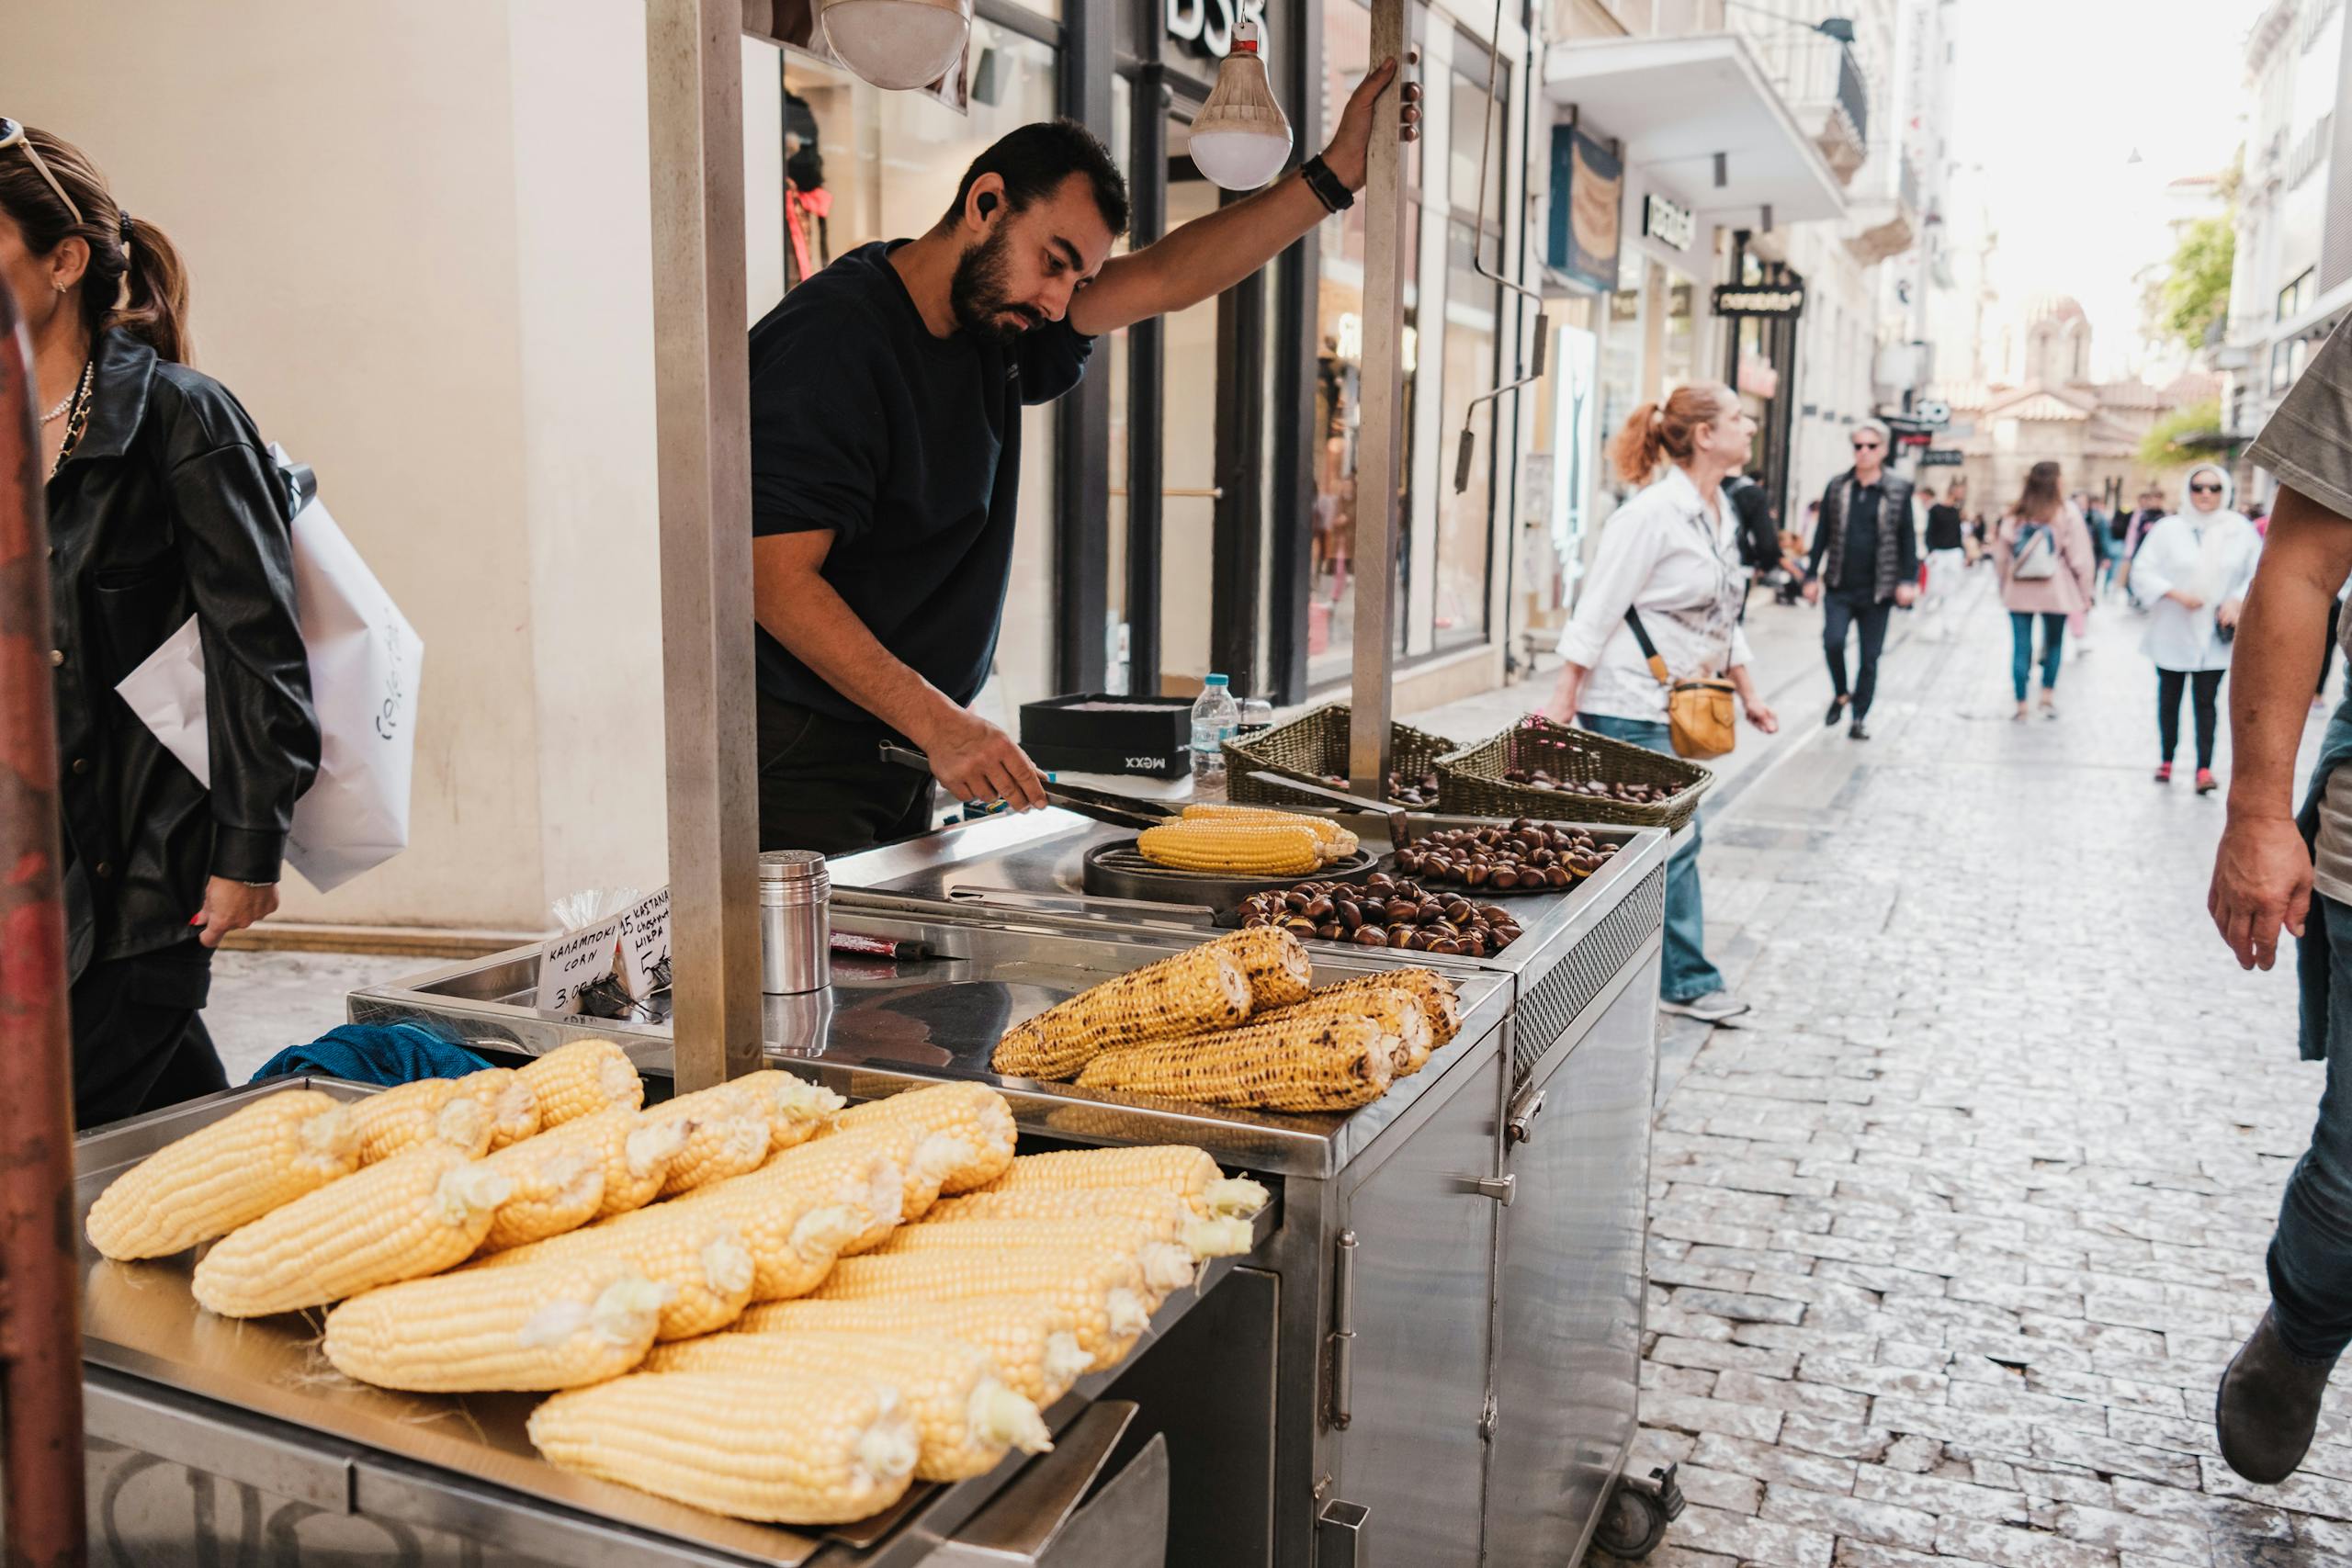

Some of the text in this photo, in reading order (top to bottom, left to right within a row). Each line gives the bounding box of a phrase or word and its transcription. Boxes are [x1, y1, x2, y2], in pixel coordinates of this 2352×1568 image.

[620, 915, 634, 936] 15
[549, 925, 616, 962] ΚΑΛΑΜΠΟΚΙ
[564, 949, 598, 972] CORN
